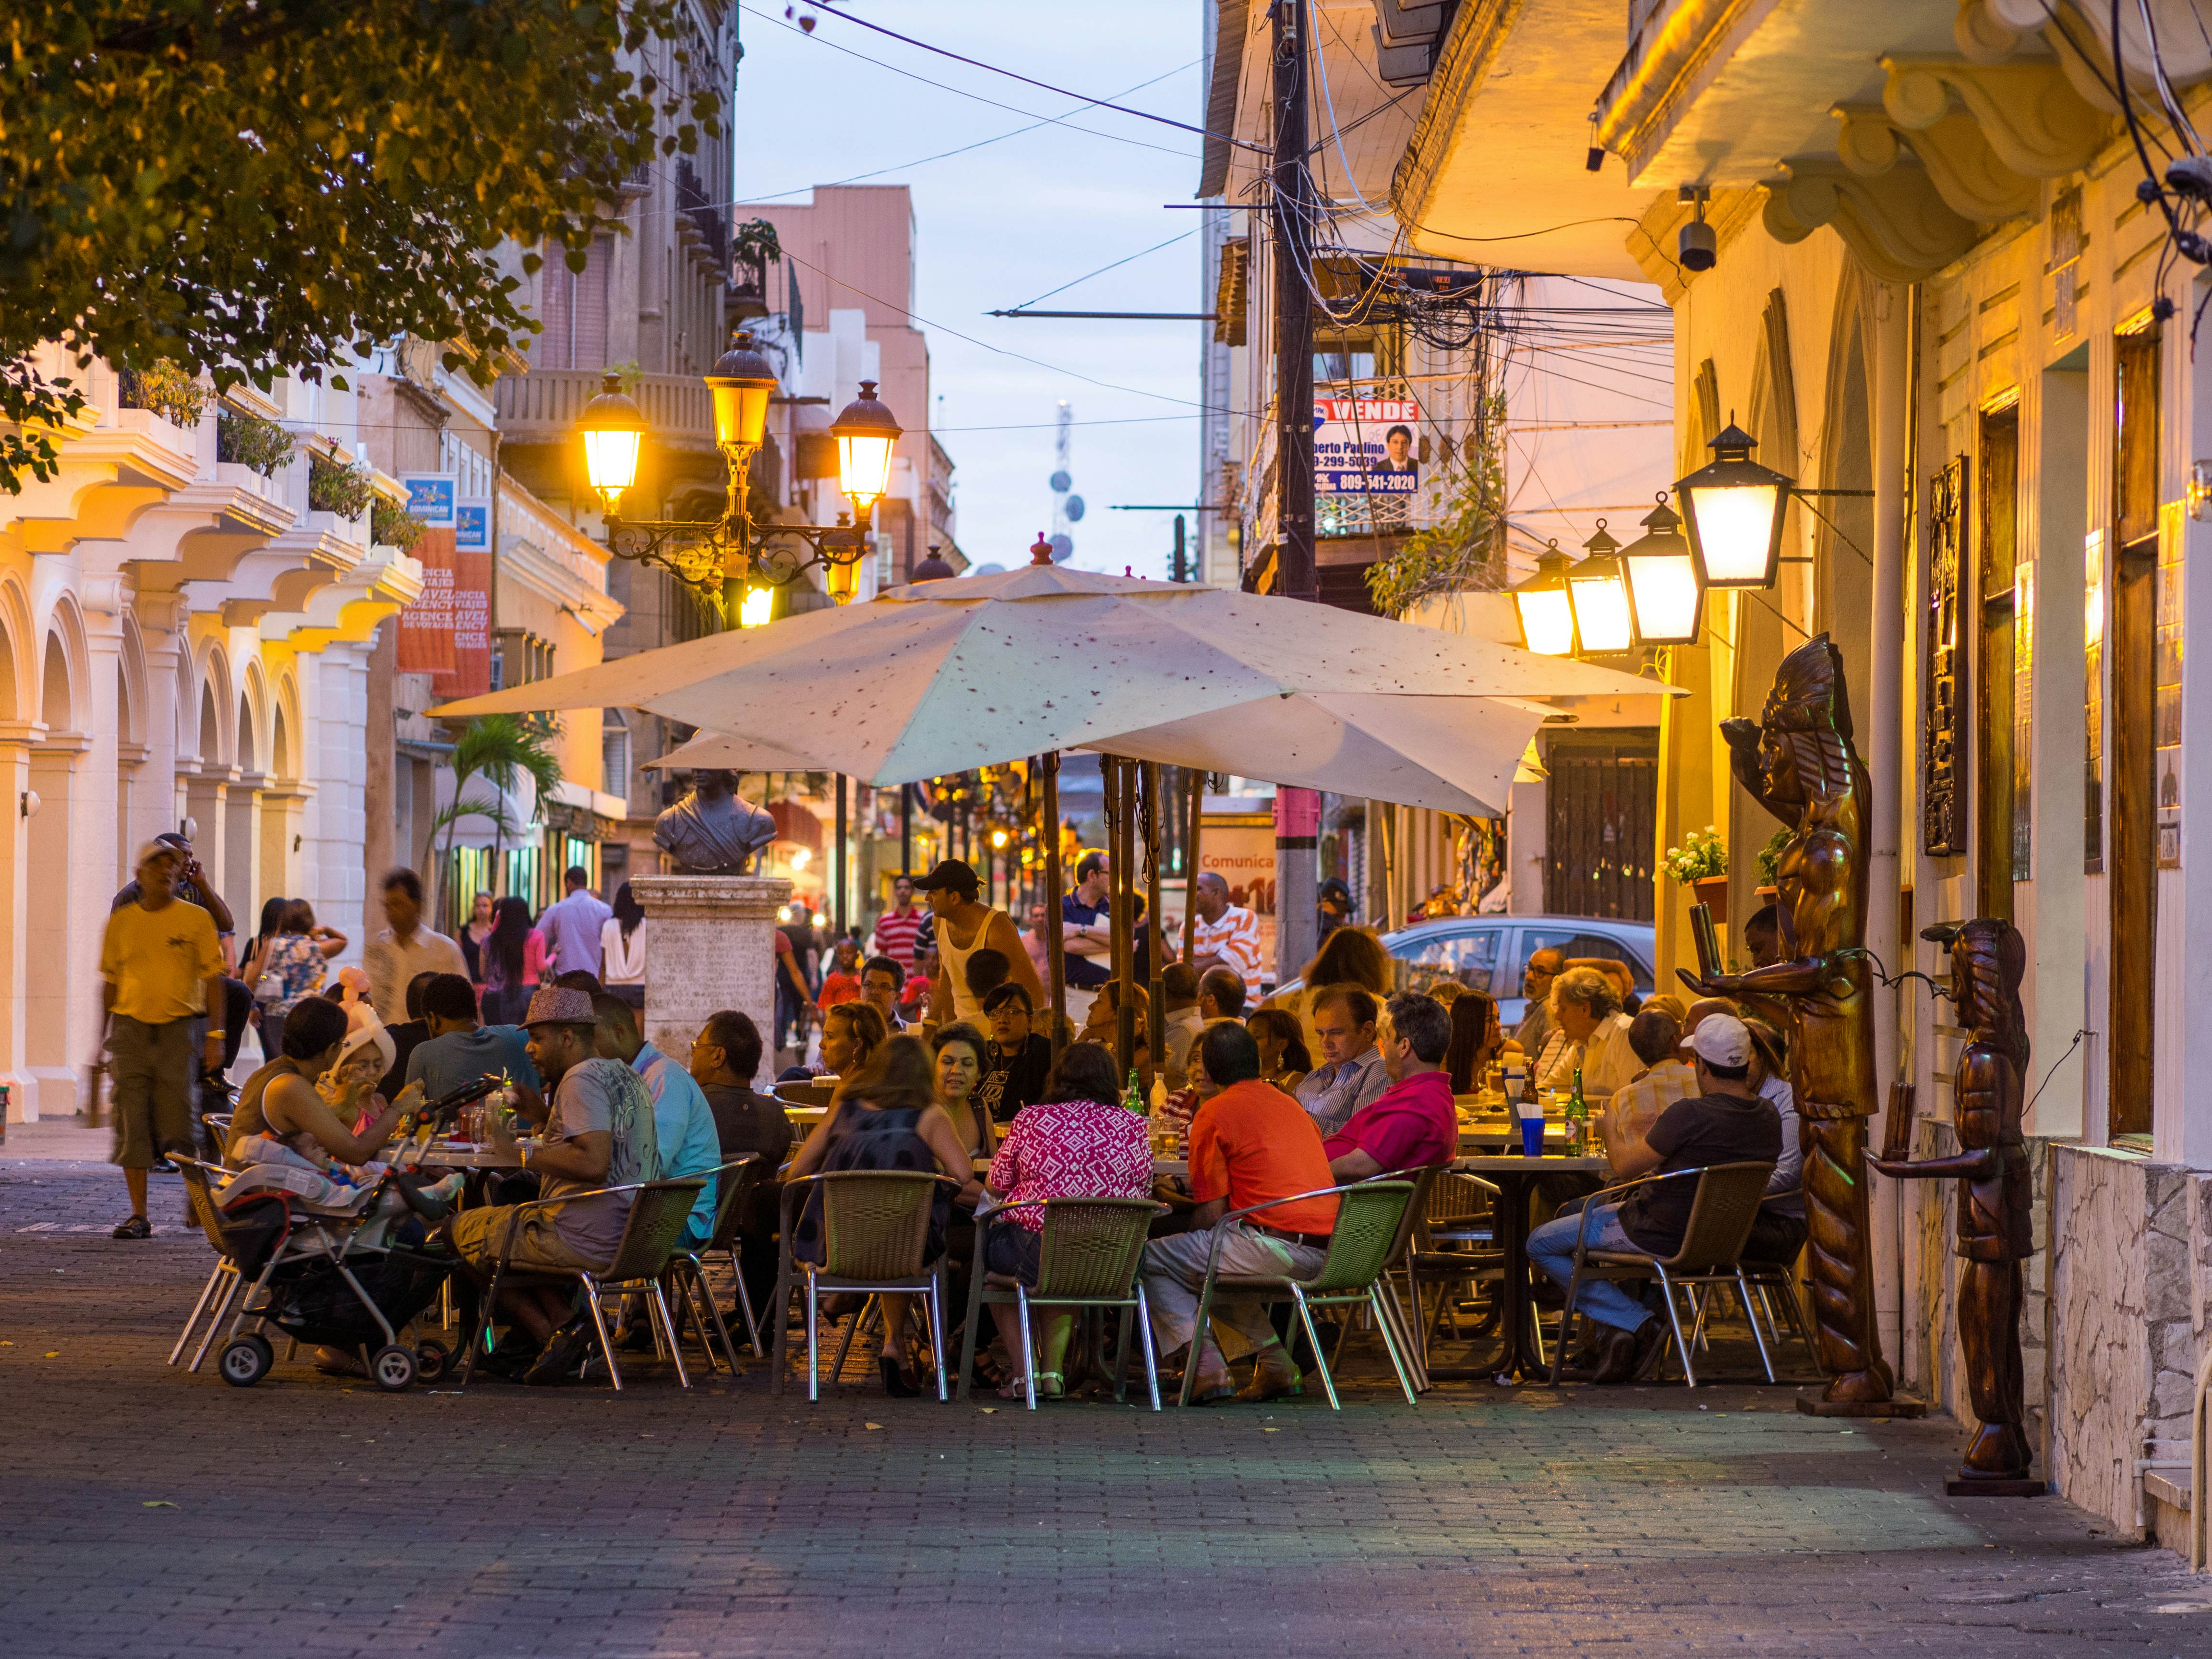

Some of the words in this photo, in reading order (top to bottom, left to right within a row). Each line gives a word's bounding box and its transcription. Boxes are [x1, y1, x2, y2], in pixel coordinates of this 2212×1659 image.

[1333, 402, 1415, 420] VENDE
[1344, 442, 1385, 454] Paulino
[1340, 474, 1415, 490] 809-541-2020
[409, 505, 448, 513] DOMINICAN
[402, 612, 453, 622] AGENCE
